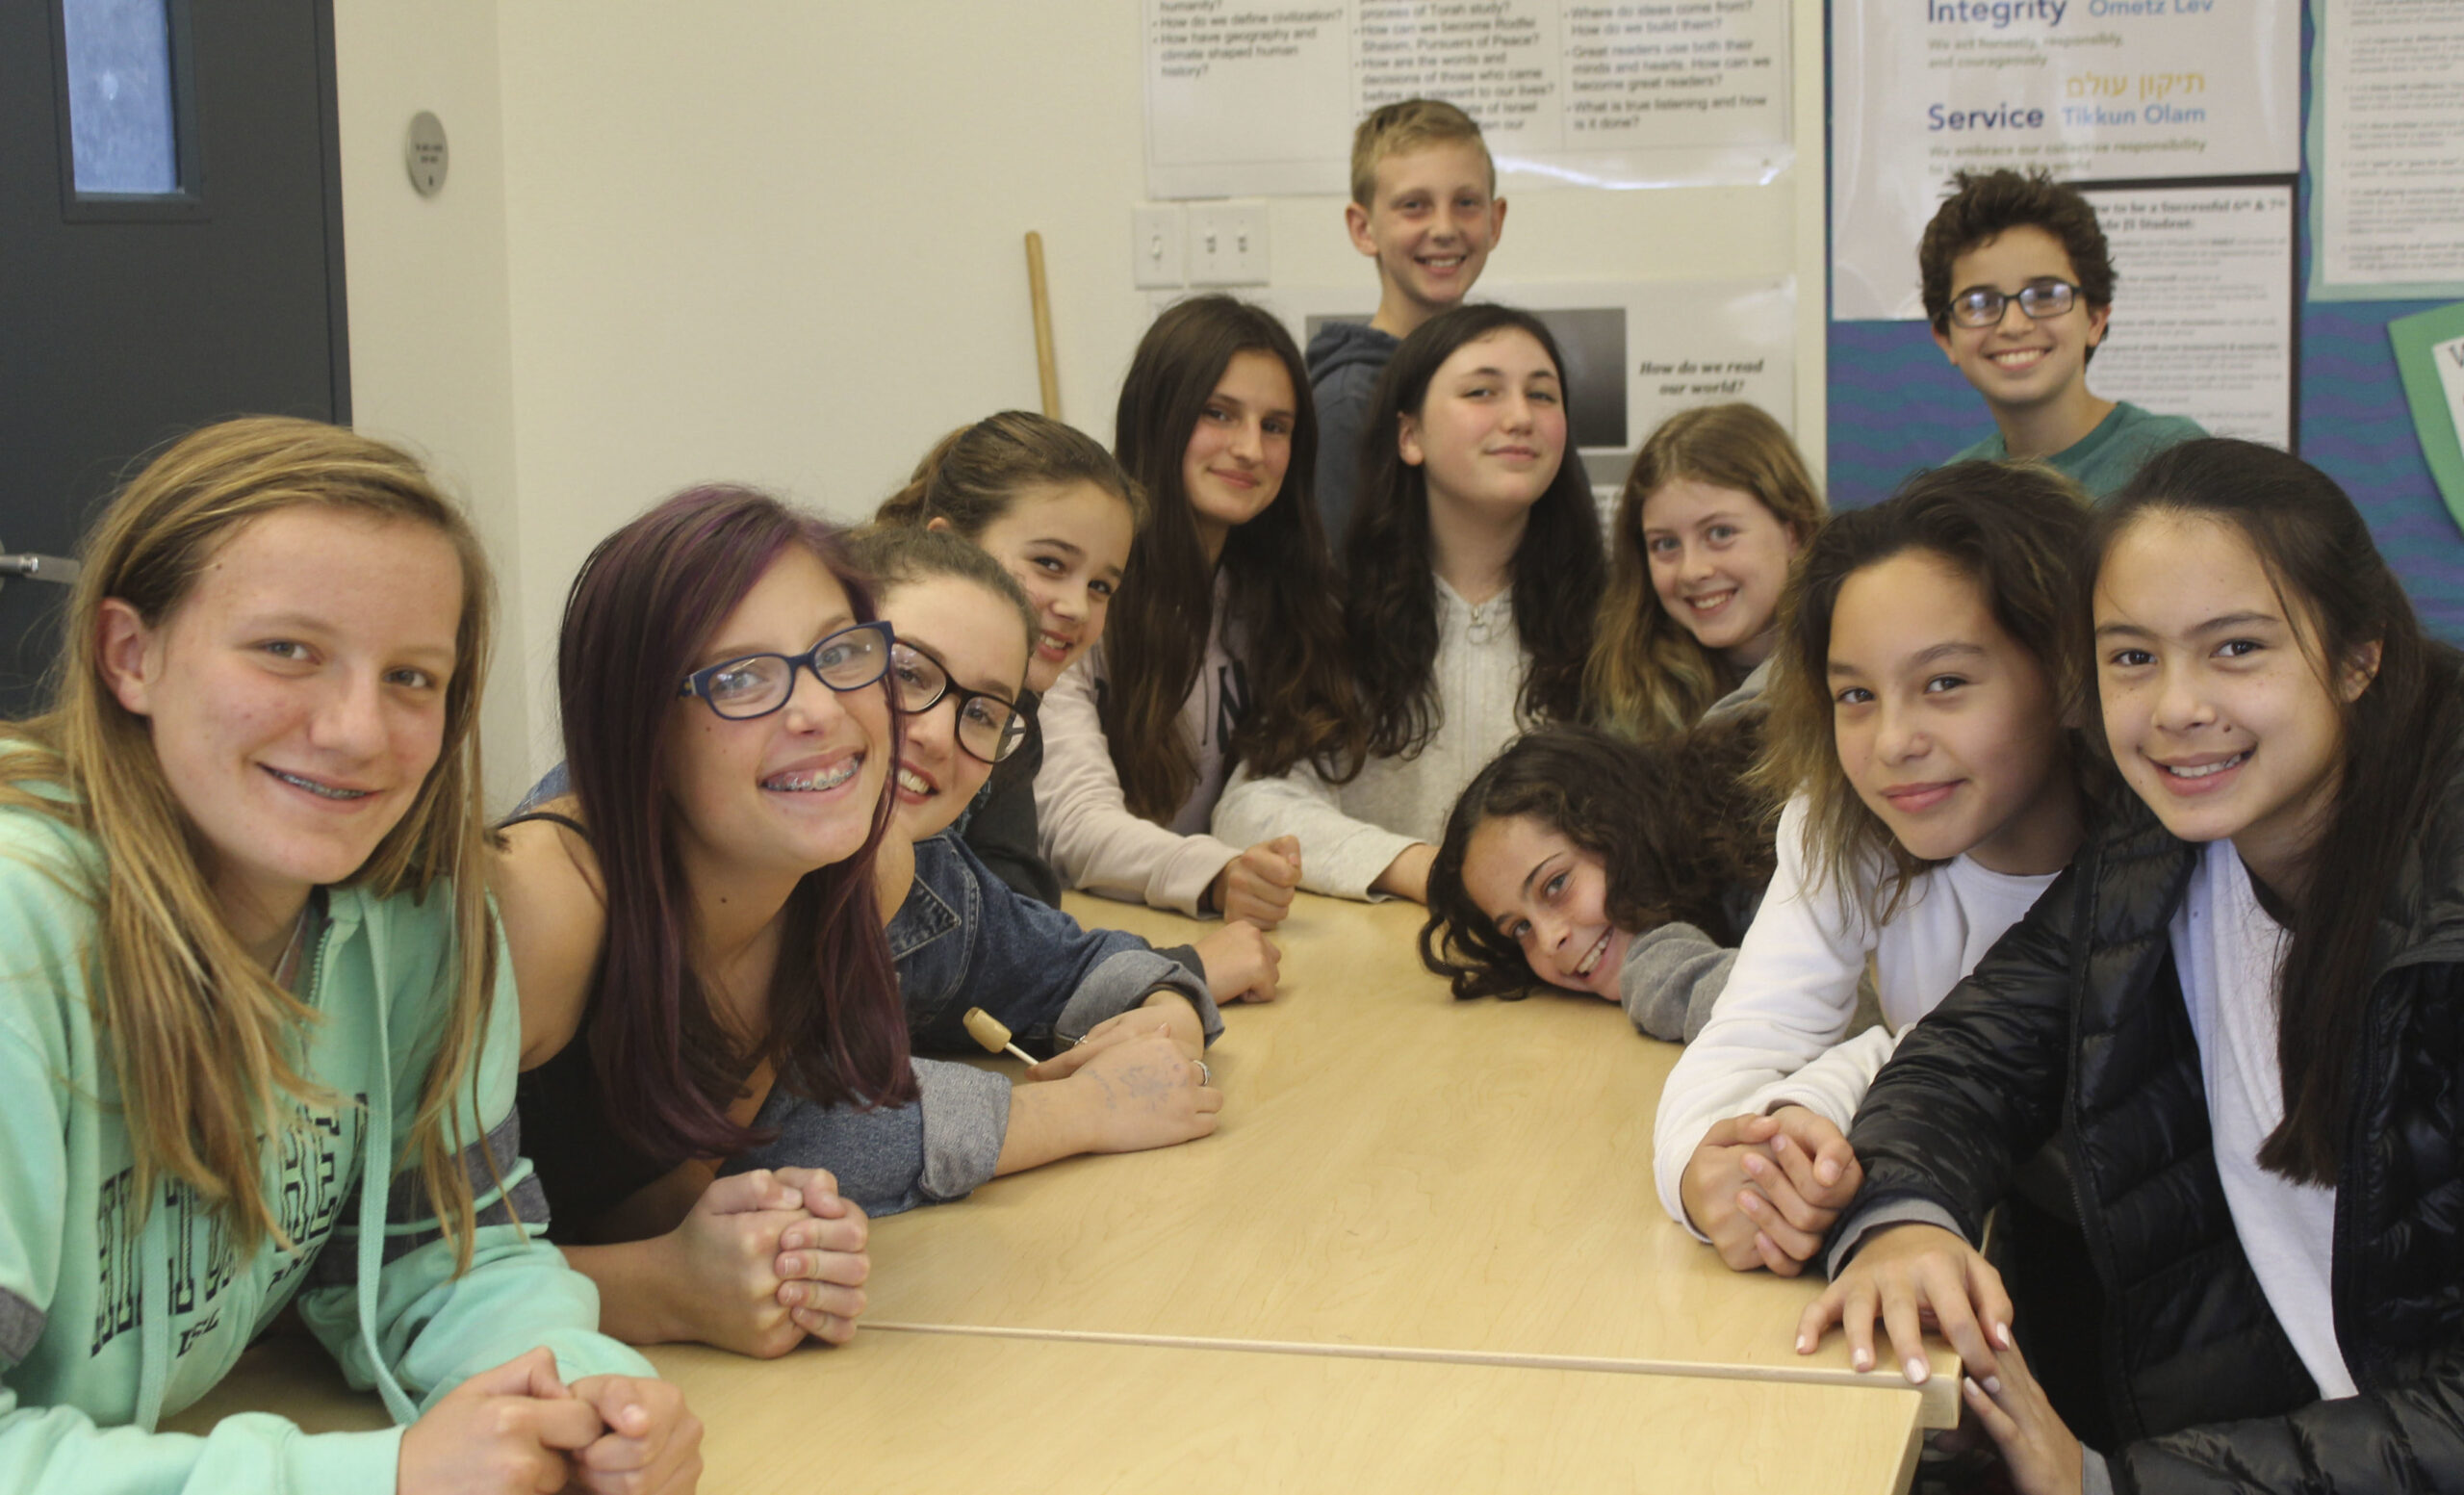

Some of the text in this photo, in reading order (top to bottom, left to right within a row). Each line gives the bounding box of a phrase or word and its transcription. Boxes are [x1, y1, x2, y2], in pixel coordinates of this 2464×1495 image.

[1161, 8, 1343, 28] How do we define civilization?
[1361, 2, 1510, 19] process of Torah study?
[1571, 0, 1754, 19] Where do ideas come from?
[1928, 0, 2213, 27] Integrity Ometz Lev
[1161, 27, 1317, 44] How have geography and
[1361, 24, 1388, 35] How
[1393, 25, 1415, 35] can
[1420, 24, 1437, 34] we
[1441, 20, 1491, 33] become
[1571, 17, 1722, 37] How do we build them?
[1417, 37, 1474, 50] Pursuers
[1476, 35, 1489, 47] of
[1492, 32, 1540, 46] Peace?
[1572, 39, 1754, 58] Great readers use both their
[1162, 45, 1299, 62] climate shaped human
[1362, 52, 1506, 68] How are the words and
[1929, 55, 1953, 68] and
[1162, 64, 1209, 79] history?
[1572, 63, 1611, 74] minds
[1615, 61, 1639, 72] and
[1691, 58, 1720, 69] How
[1724, 58, 1748, 68] can
[1753, 57, 1771, 66] we
[1362, 69, 1542, 85] decisions of those who came
[1573, 74, 1723, 92] become great readers?
[1362, 90, 1402, 102] before
[1424, 87, 1475, 100] relevant
[1478, 88, 1491, 98] to
[1495, 89, 1514, 98] our
[1519, 83, 1554, 96] lives?
[2066, 71, 2206, 101] תיקון עולם
[1487, 102, 1501, 115] of
[1503, 102, 1538, 114] Israel
[1575, 94, 1767, 113] What is true listening and how
[1574, 116, 1640, 131] is it done?
[1928, 102, 2206, 131] Service Tikkun Olam
[1503, 120, 1526, 131] our
[2114, 201, 2126, 213] to
[2130, 199, 2145, 213] be
[2162, 197, 2230, 213] Successful
[1639, 356, 1764, 375] How do we read
[1658, 377, 1746, 396] our world?
